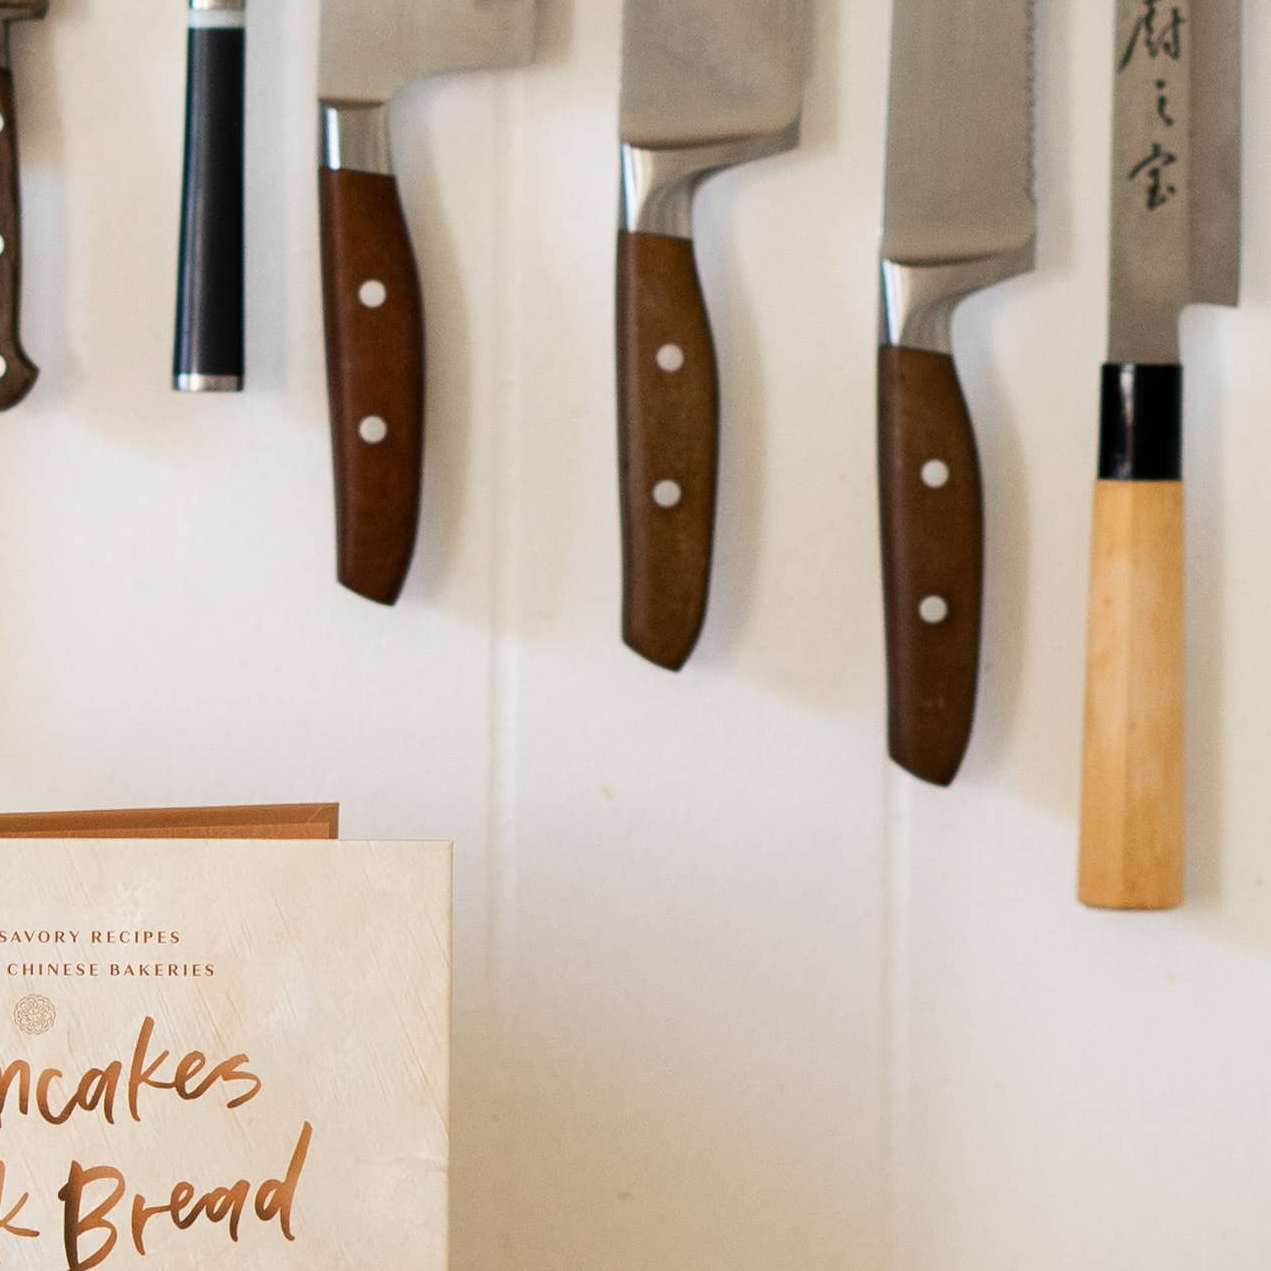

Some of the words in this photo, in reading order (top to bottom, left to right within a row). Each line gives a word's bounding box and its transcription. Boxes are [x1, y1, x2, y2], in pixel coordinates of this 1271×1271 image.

[90, 930, 181, 945] RECIPES
[6, 962, 98, 977] CHINESE
[109, 963, 216, 977] BAKERIES
